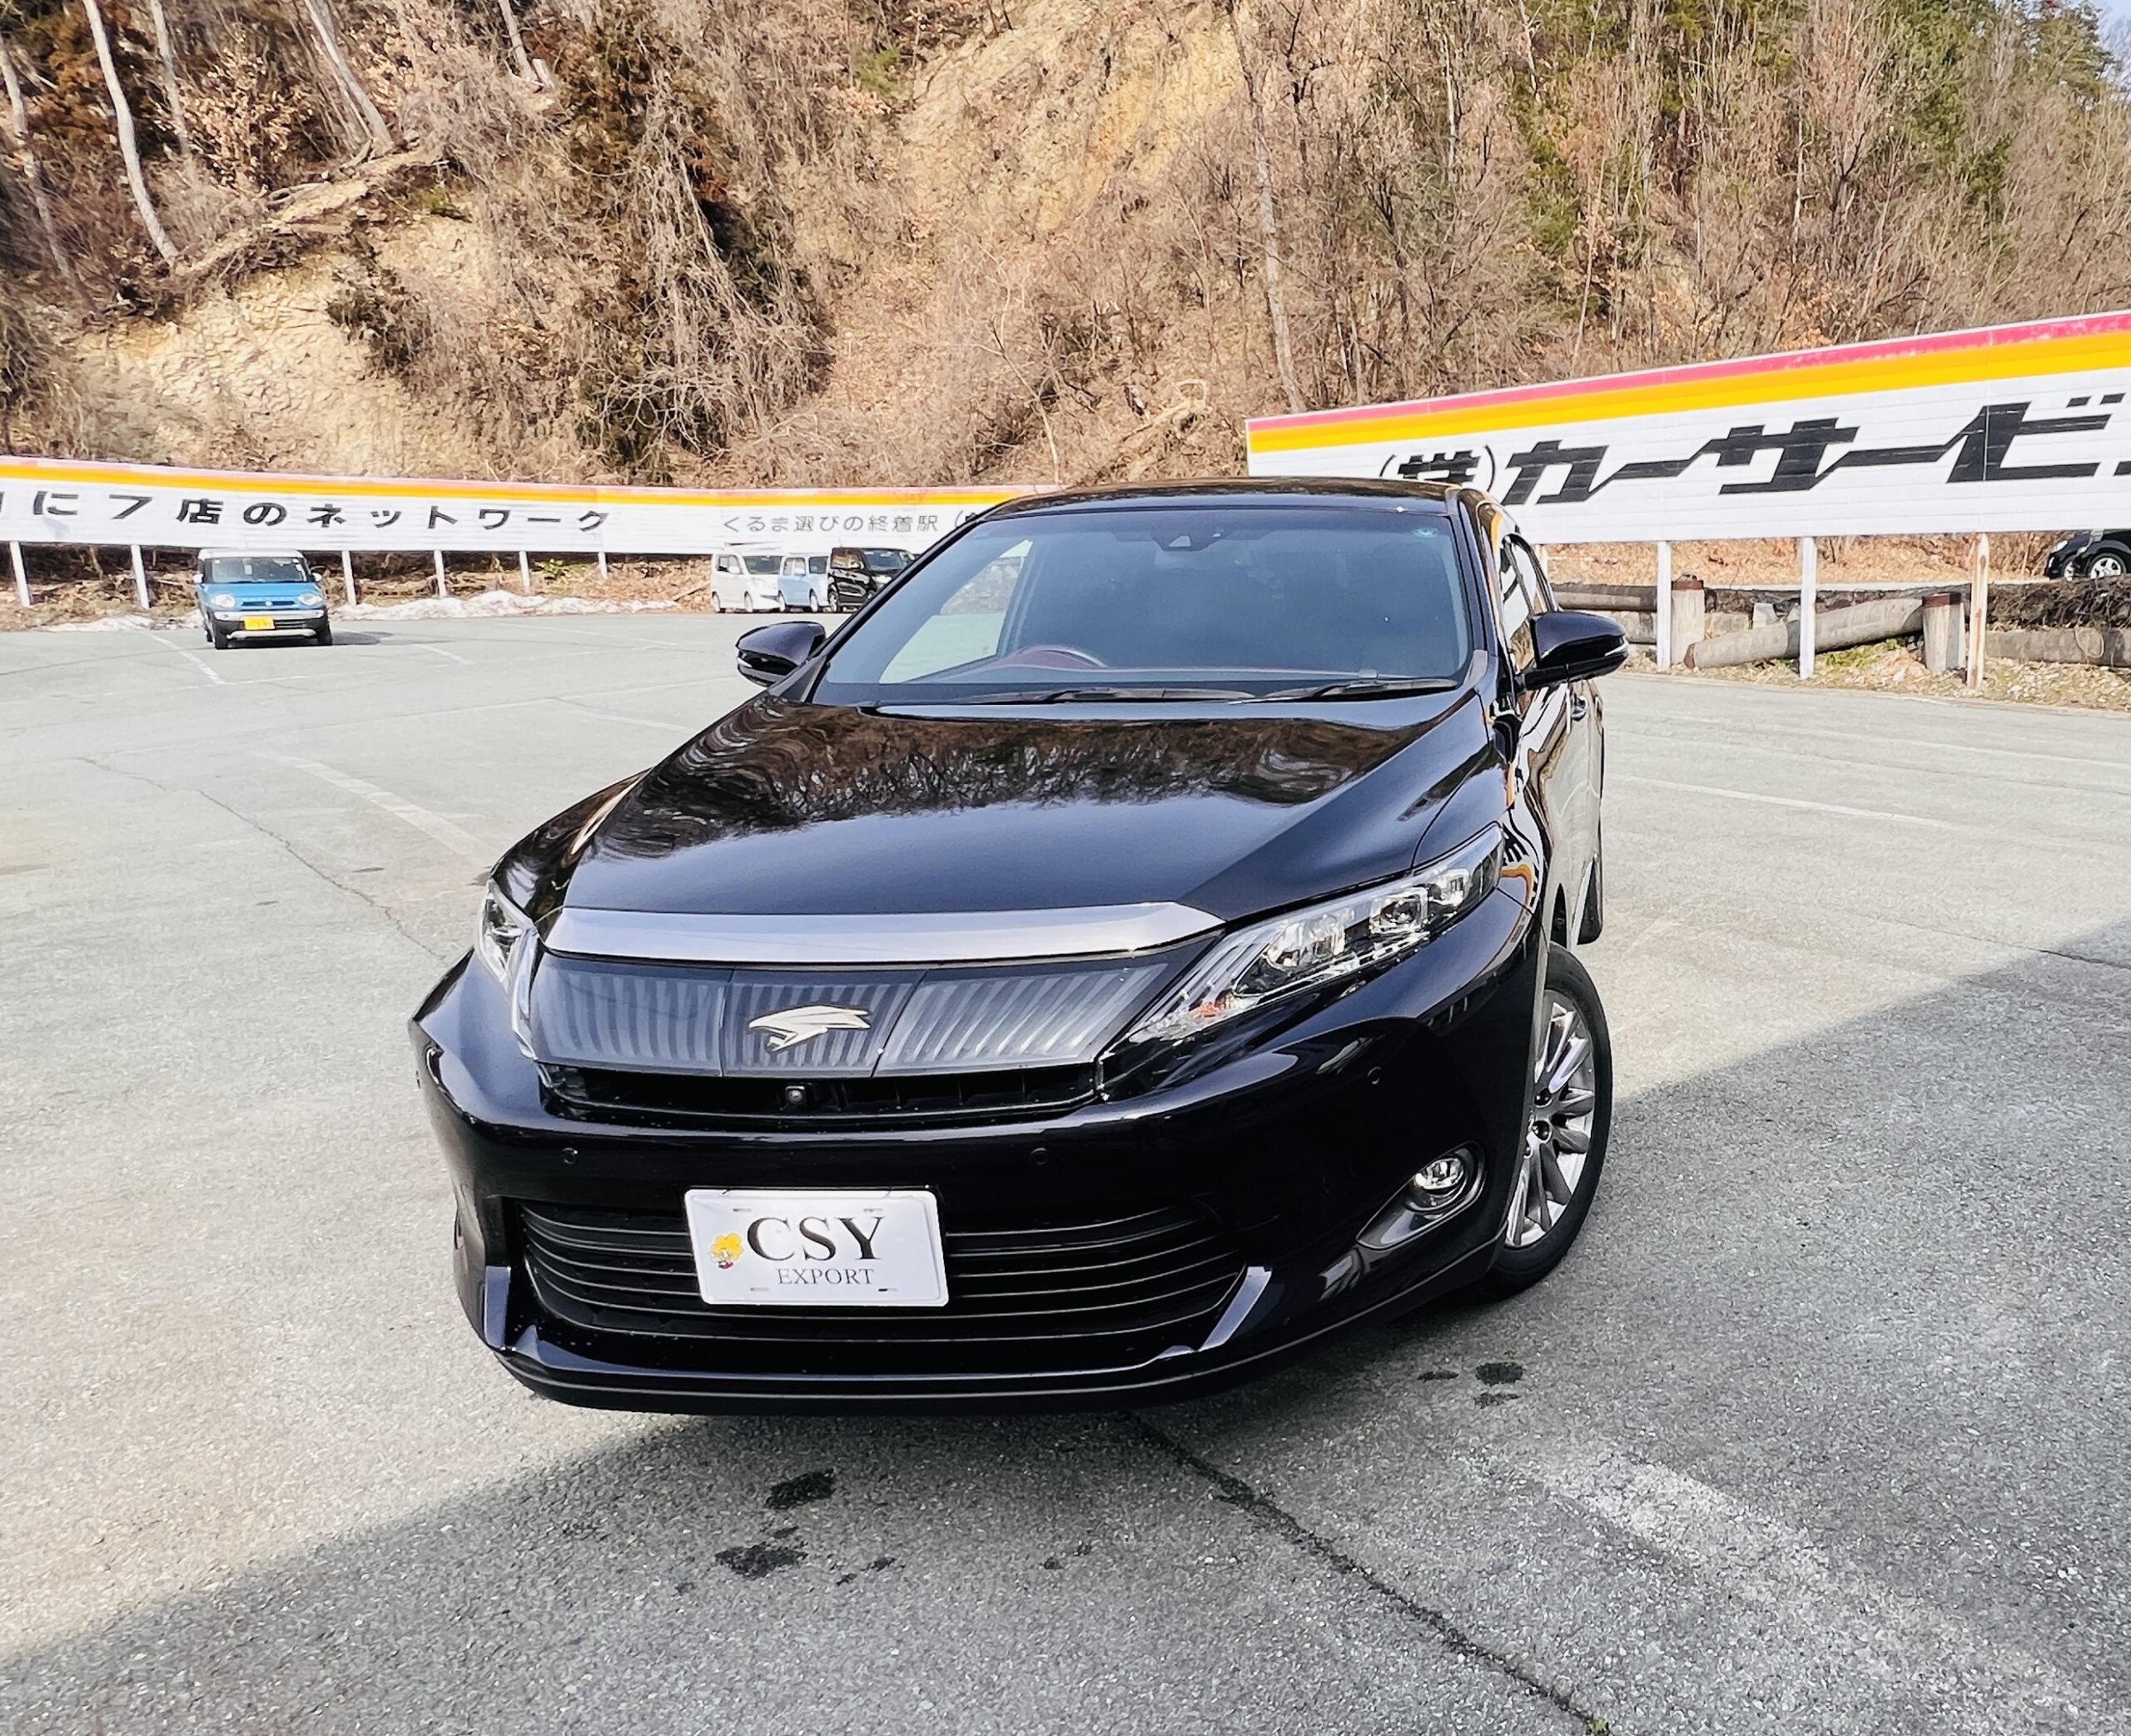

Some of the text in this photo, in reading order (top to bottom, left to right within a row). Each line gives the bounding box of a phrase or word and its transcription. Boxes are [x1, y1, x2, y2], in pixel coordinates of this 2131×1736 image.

[1379, 393, 2131, 506] (株)カーサービ
[747, 1217, 885, 1262] CSY
[777, 1268, 873, 1285] EXPORT
